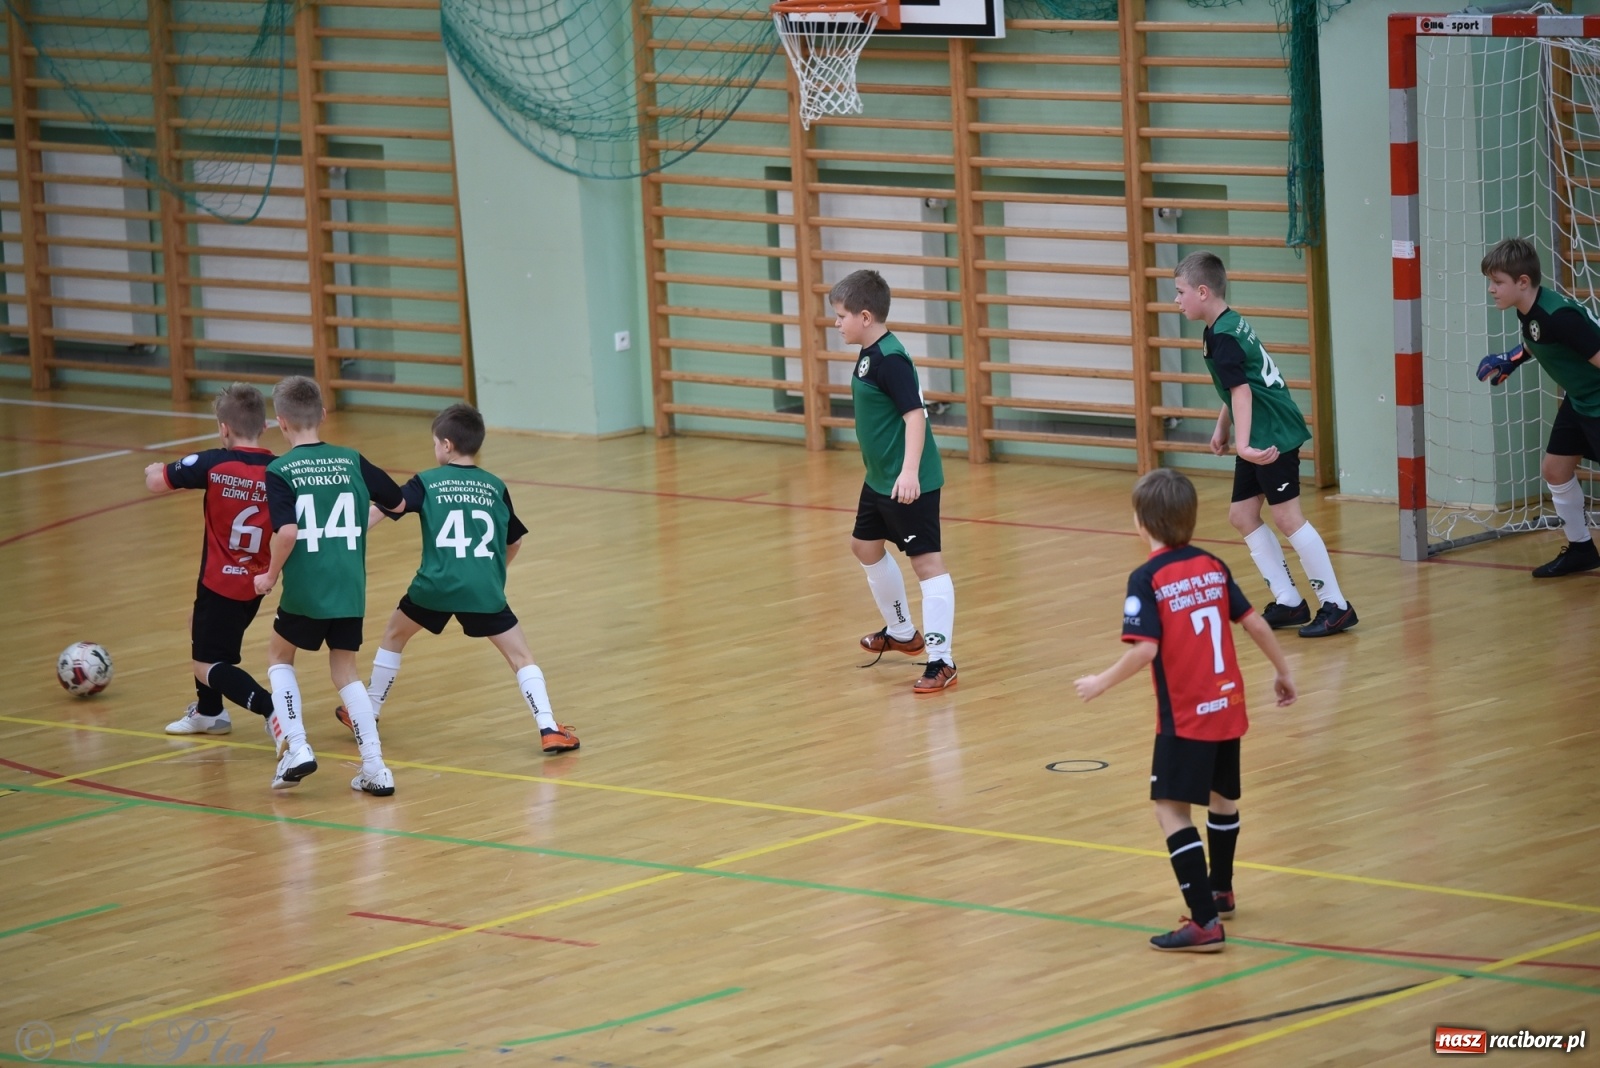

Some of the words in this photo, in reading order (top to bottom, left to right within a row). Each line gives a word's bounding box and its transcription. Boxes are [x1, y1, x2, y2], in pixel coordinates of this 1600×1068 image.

[1451, 20, 1480, 32] sport
[210, 472, 254, 488] AKADEMIA
[291, 472, 352, 489] TWORKÓW
[222, 486, 249, 501] GÓRKI
[435, 493, 495, 508] TWORKÓW
[228, 505, 263, 554] 6
[295, 492, 362, 552] 44
[435, 509, 495, 560] 42
[1189, 605, 1225, 675] 7
